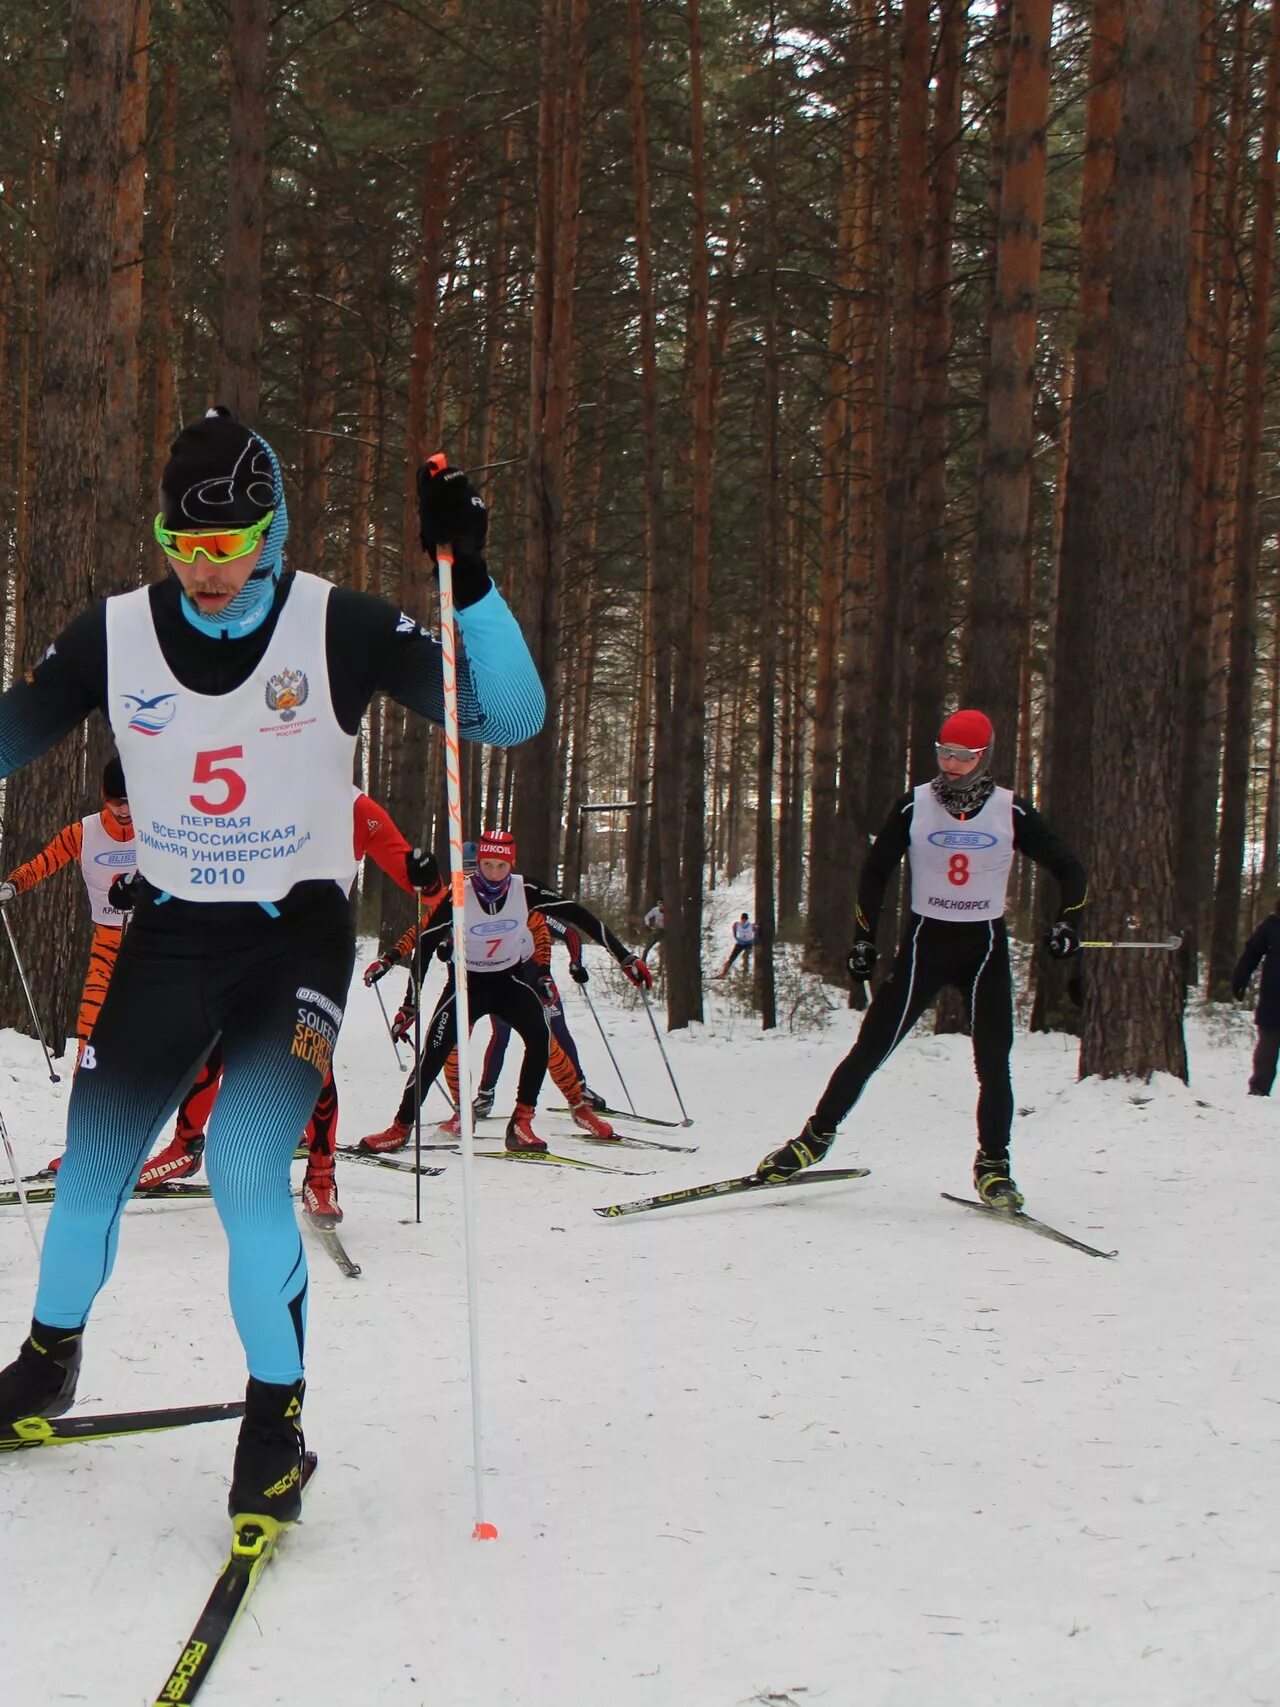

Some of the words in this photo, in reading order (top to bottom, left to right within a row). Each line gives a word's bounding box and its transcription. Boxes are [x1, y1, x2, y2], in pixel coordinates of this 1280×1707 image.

[189, 745, 247, 816] 5
[180, 815, 251, 828] ПЕРВАЯ
[152, 821, 296, 846] ВСЕРОССИЙСКАЯ
[943, 835, 980, 845] BLISS
[138, 830, 188, 859] ЗИМНЯЯ
[191, 832, 312, 862] УНИВЕРСИАДА
[480, 844, 511, 855] LUKOIL
[190, 868, 246, 885] 2010
[948, 853, 970, 886] 8
[928, 896, 991, 911] КРАСНОЯРСК
[486, 939, 503, 958] 7
[333, 1151, 380, 1167] SCHER
[161, 1639, 209, 1700] FISCHER
